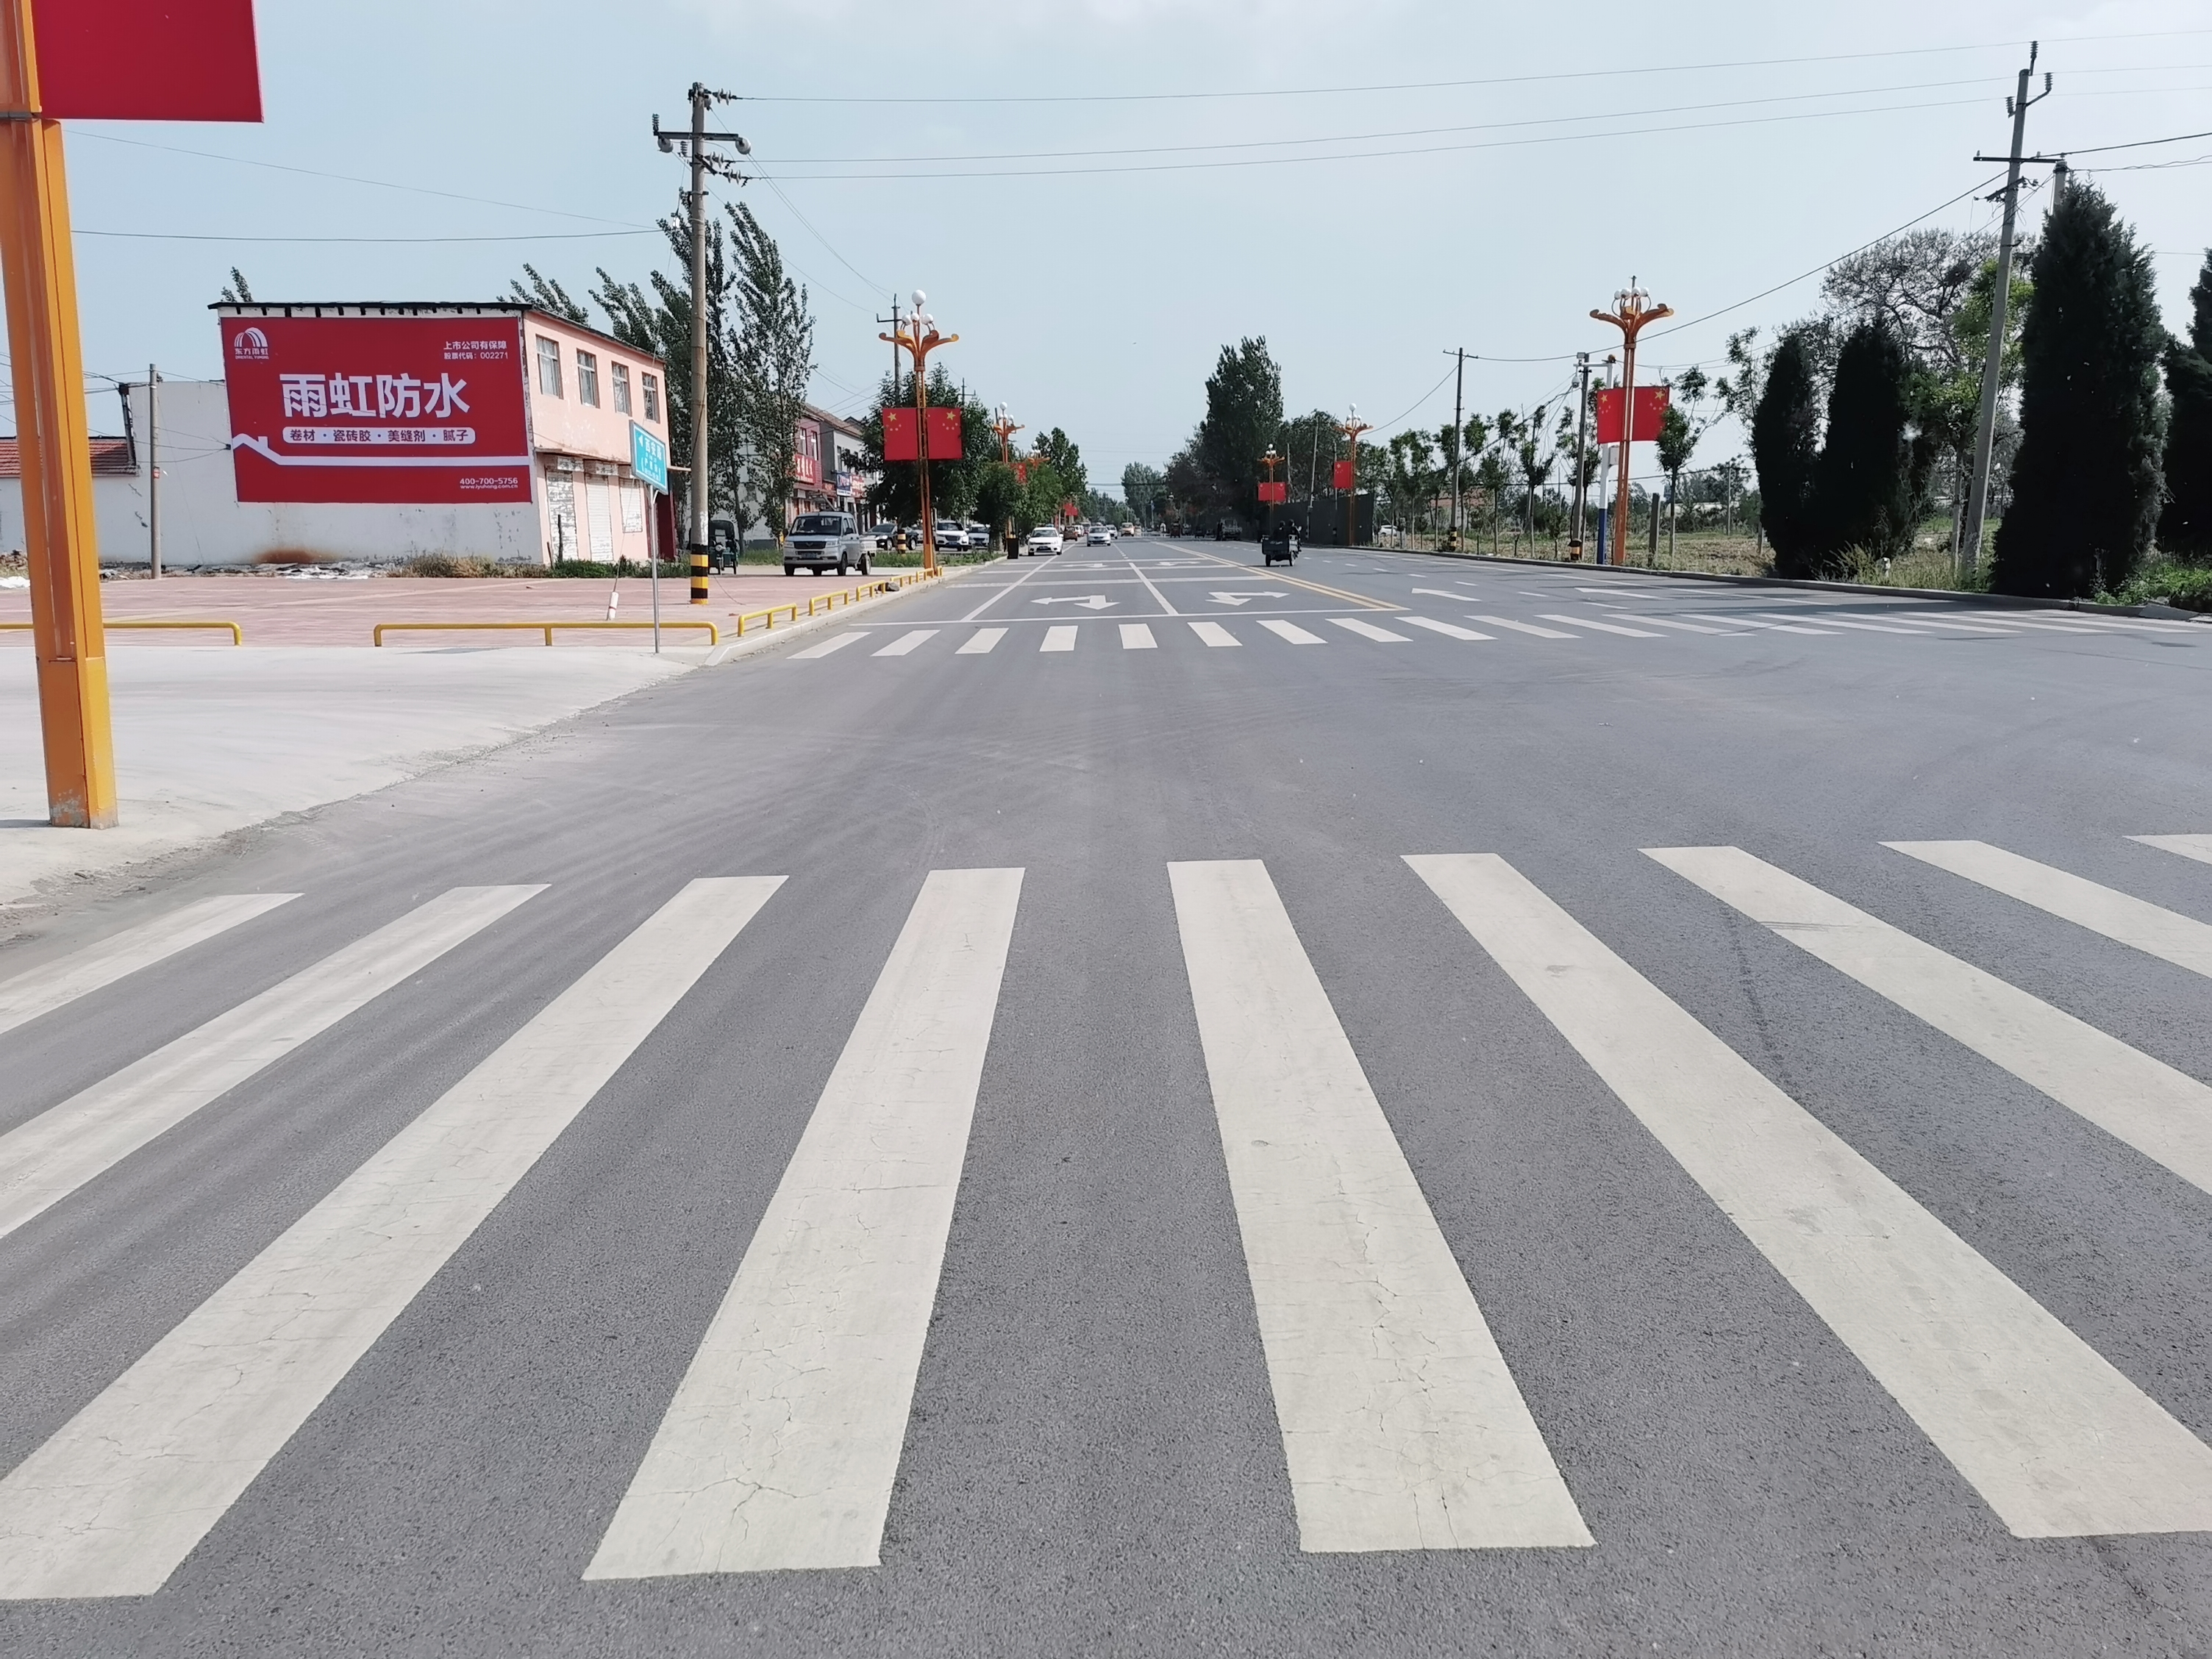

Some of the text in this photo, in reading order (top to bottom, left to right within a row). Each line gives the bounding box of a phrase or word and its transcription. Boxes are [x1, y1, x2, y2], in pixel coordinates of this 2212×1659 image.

[443, 340, 507, 350] 上市公司有保障
[279, 372, 471, 418] 雨虹防水
